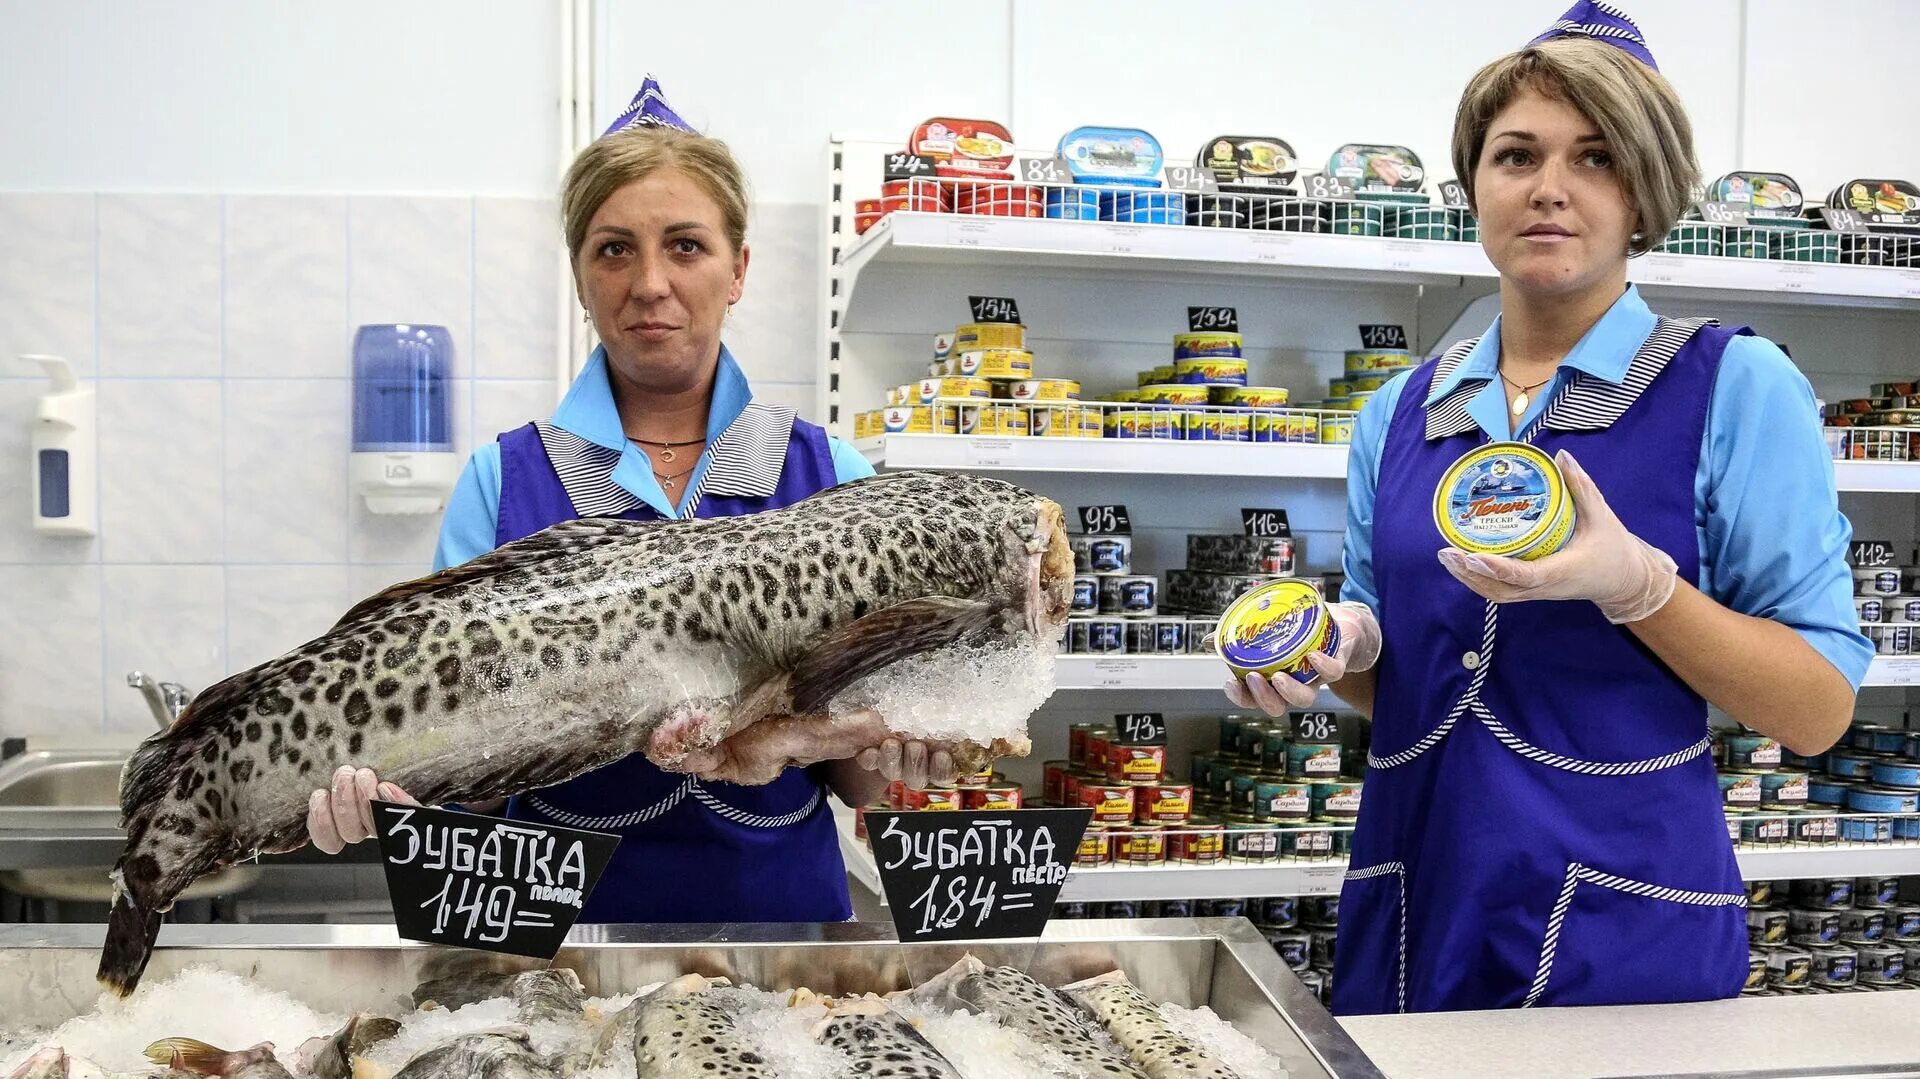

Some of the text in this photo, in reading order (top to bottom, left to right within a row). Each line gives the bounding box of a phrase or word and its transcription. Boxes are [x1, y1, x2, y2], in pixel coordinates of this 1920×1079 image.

[1460, 495, 1532, 520] Печень
[385, 808, 585, 889] ЗУБАТКА
[881, 816, 1056, 869] ЗУБАТКА
